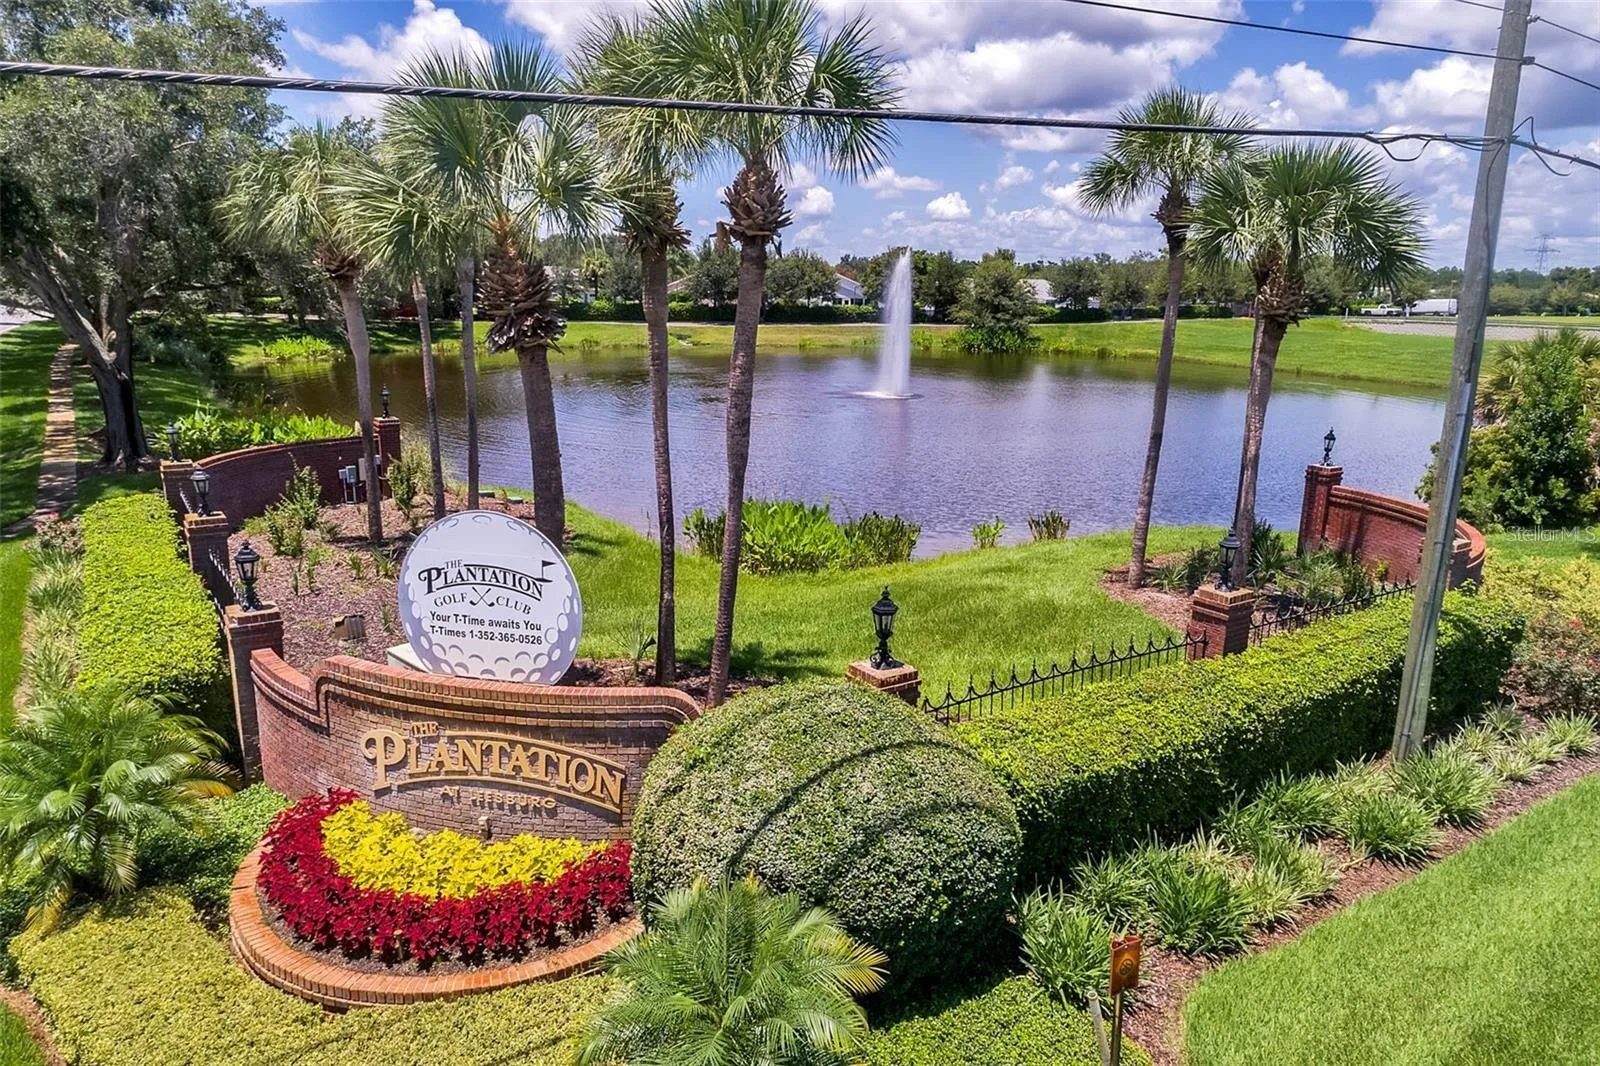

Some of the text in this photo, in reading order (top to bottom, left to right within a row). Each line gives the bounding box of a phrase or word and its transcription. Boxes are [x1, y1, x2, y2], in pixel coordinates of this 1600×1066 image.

[444, 559, 463, 569] THE
[417, 566, 543, 599] PLANTATION
[434, 592, 532, 615] GOLF CLUB
[430, 611, 542, 631] Your T-Time awaits You
[430, 625, 543, 645] T-Times 1-352-365-0526
[411, 721, 438, 737] THE
[360, 729, 626, 805] PLANTATION
